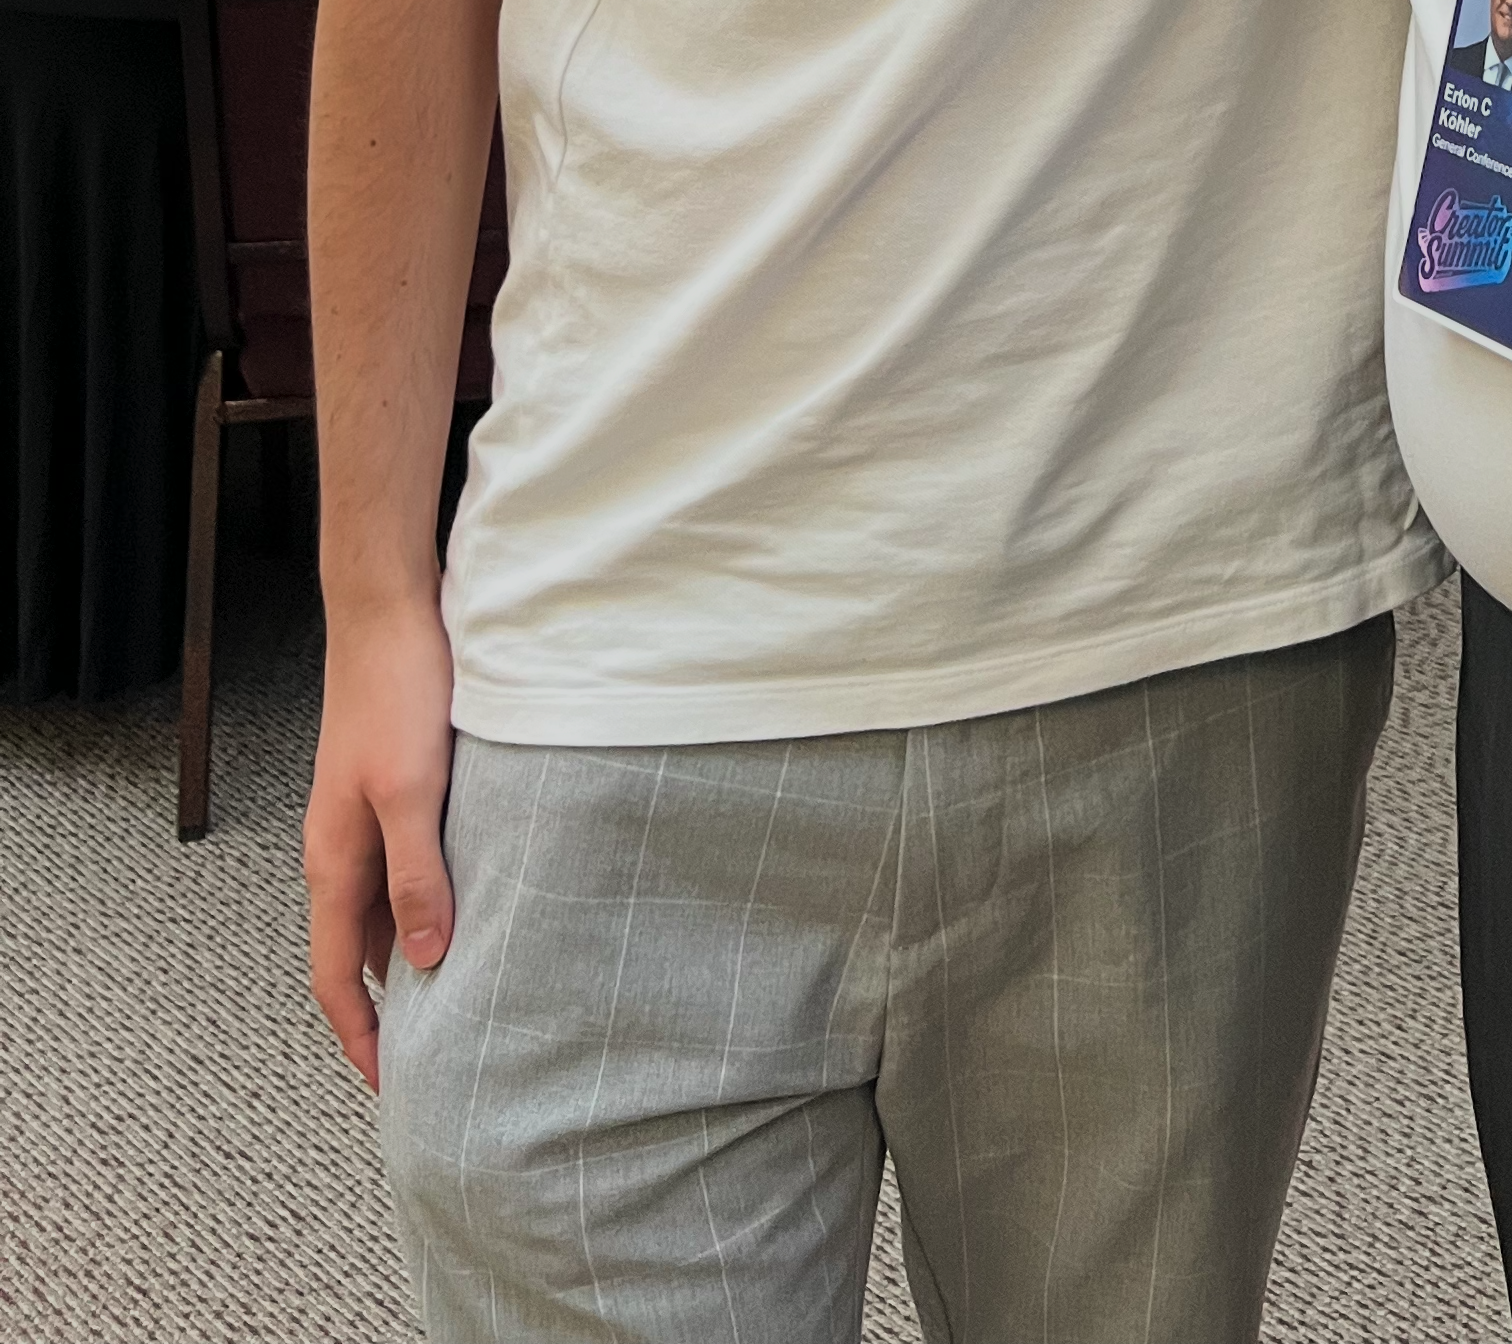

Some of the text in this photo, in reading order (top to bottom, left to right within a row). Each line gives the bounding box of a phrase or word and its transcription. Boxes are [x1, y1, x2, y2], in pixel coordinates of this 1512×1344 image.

[1443, 82, 1492, 117] Erton C
[1432, 133, 1465, 158] General
[1420, 234, 1512, 280] Summit
